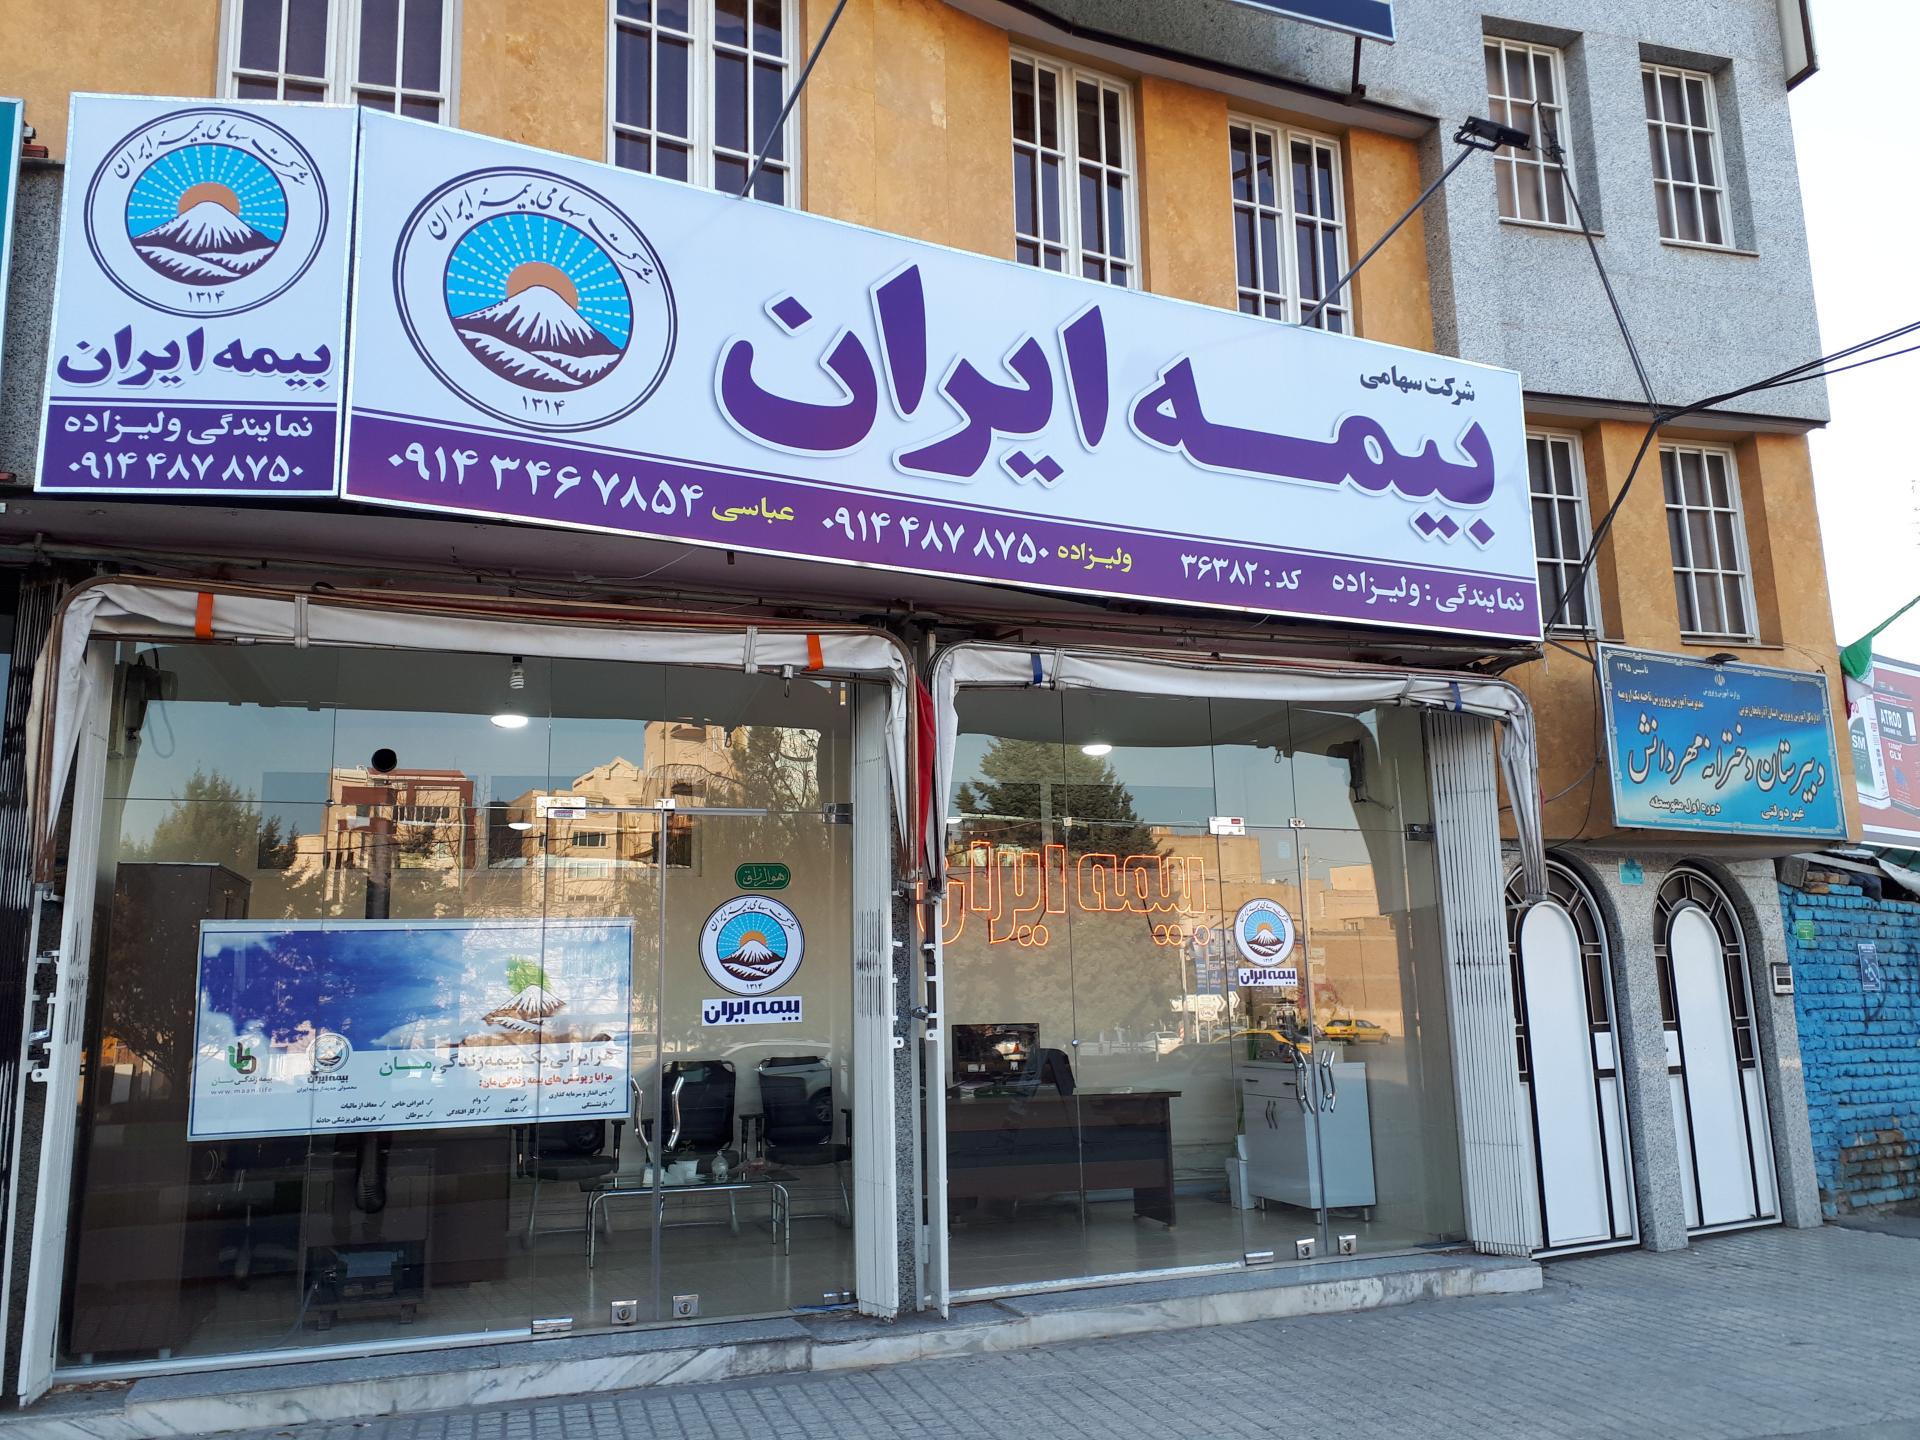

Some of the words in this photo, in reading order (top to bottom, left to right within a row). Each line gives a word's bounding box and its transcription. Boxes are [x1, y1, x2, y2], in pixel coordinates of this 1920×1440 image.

[207, 119, 249, 142] سهامی
[113, 135, 153, 179] ایران
[251, 138, 308, 185] شرکت
[428, 189, 473, 240] ایران
[536, 187, 586, 217] سهامی
[587, 217, 653, 284] شرکت
[188, 290, 225, 304] ۱۳۱۴
[56, 324, 205, 386] ایران
[212, 338, 332, 389] بیمه
[720, 262, 1108, 482] ایران
[1360, 365, 1422, 394] سهامی
[1424, 377, 1475, 405] شرکت
[523, 395, 565, 416] ۱۳۱۴
[64, 409, 181, 443] ولیزاده
[187, 413, 313, 445] نمایندگی
[1133, 356, 1496, 549] بیمه
[68, 451, 138, 480] ۰۹۱۴
[146, 452, 214, 481] ۴۸۷
[221, 454, 304, 483] ۸۷۵۰
[388, 441, 479, 485] ۰۹۱۴
[490, 453, 582, 500] ۳۴۶
[591, 469, 704, 518] ۷۸۵۴
[711, 496, 795, 522] عباسی
[822, 507, 891, 544] ۰۹۱۴
[899, 515, 965, 554] ۴۸۷
[973, 527, 1049, 565] ۸۷۵۰
[1057, 542, 1133, 574] ولیزاده
[1180, 552, 1258, 586] ۳۶۳۸۲
[1332, 571, 1421, 607] ولیزاده
[1702, 723, 1755, 790] دخترانه
[1756, 739, 1826, 803] دبیرستان
[1649, 795, 1685, 814] متوسطه
[1684, 799, 1700, 814] اول
[1699, 800, 1722, 816] دوره
[1761, 804, 1790, 820] دولتی
[1788, 806, 1805, 822] غیر
[1078, 852, 1211, 947] بیمه
[710, 909, 727, 932] ایران
[1240, 969, 1267, 985] ایران
[1268, 970, 1296, 985] بیمه
[704, 1000, 750, 1024] ایران
[752, 1000, 800, 1021] بیمه
[379, 1056, 433, 1077] مان
[485, 1056, 519, 1070] بیمه
[549, 1047, 593, 1069] ایرانی
[234, 1075, 258, 1085] زندگی
[307, 1075, 328, 1084] ایران
[329, 1075, 349, 1083] بیمه
[498, 1075, 526, 1088] زندگی
[544, 1074, 561, 1085] های
[594, 1072, 613, 1083] مزایا
